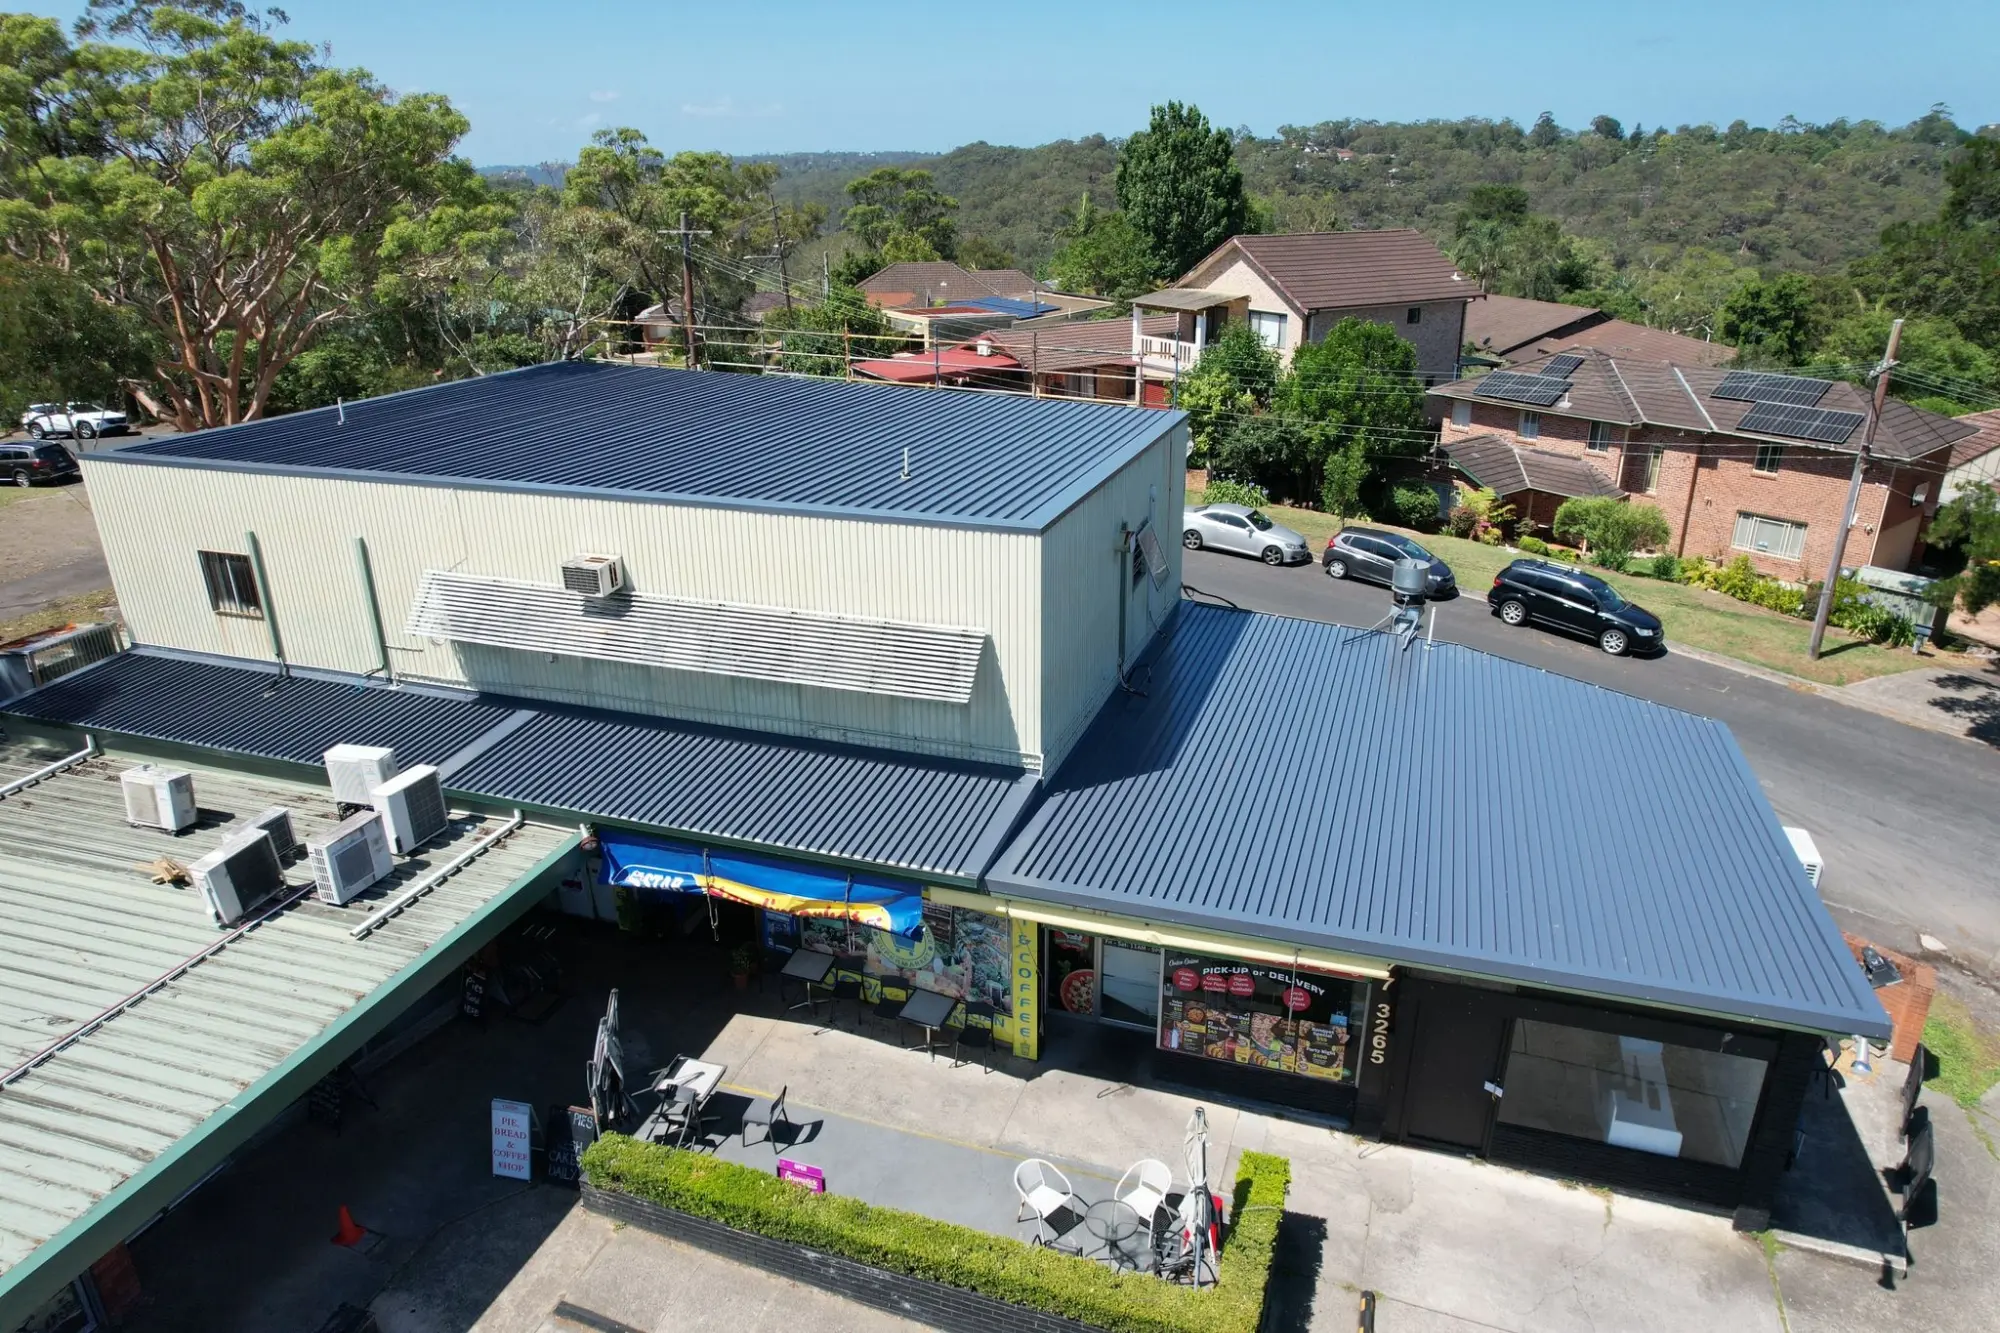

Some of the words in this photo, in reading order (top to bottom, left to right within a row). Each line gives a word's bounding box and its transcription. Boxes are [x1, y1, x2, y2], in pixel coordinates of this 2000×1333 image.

[1202, 966, 1249, 975] PICK-UP
[1252, 970, 1265, 978] or
[1268, 971, 1325, 996] DELVERY
[1018, 952, 1031, 1037] COFFEE
[1369, 1003, 1391, 1064] 3265
[573, 1112, 593, 1130] PIES
[494, 1127, 527, 1140] BREAD
[493, 1149, 528, 1161] COFFEE
[498, 1161, 524, 1173] SHOP
[548, 1163, 578, 1181] DAILY
